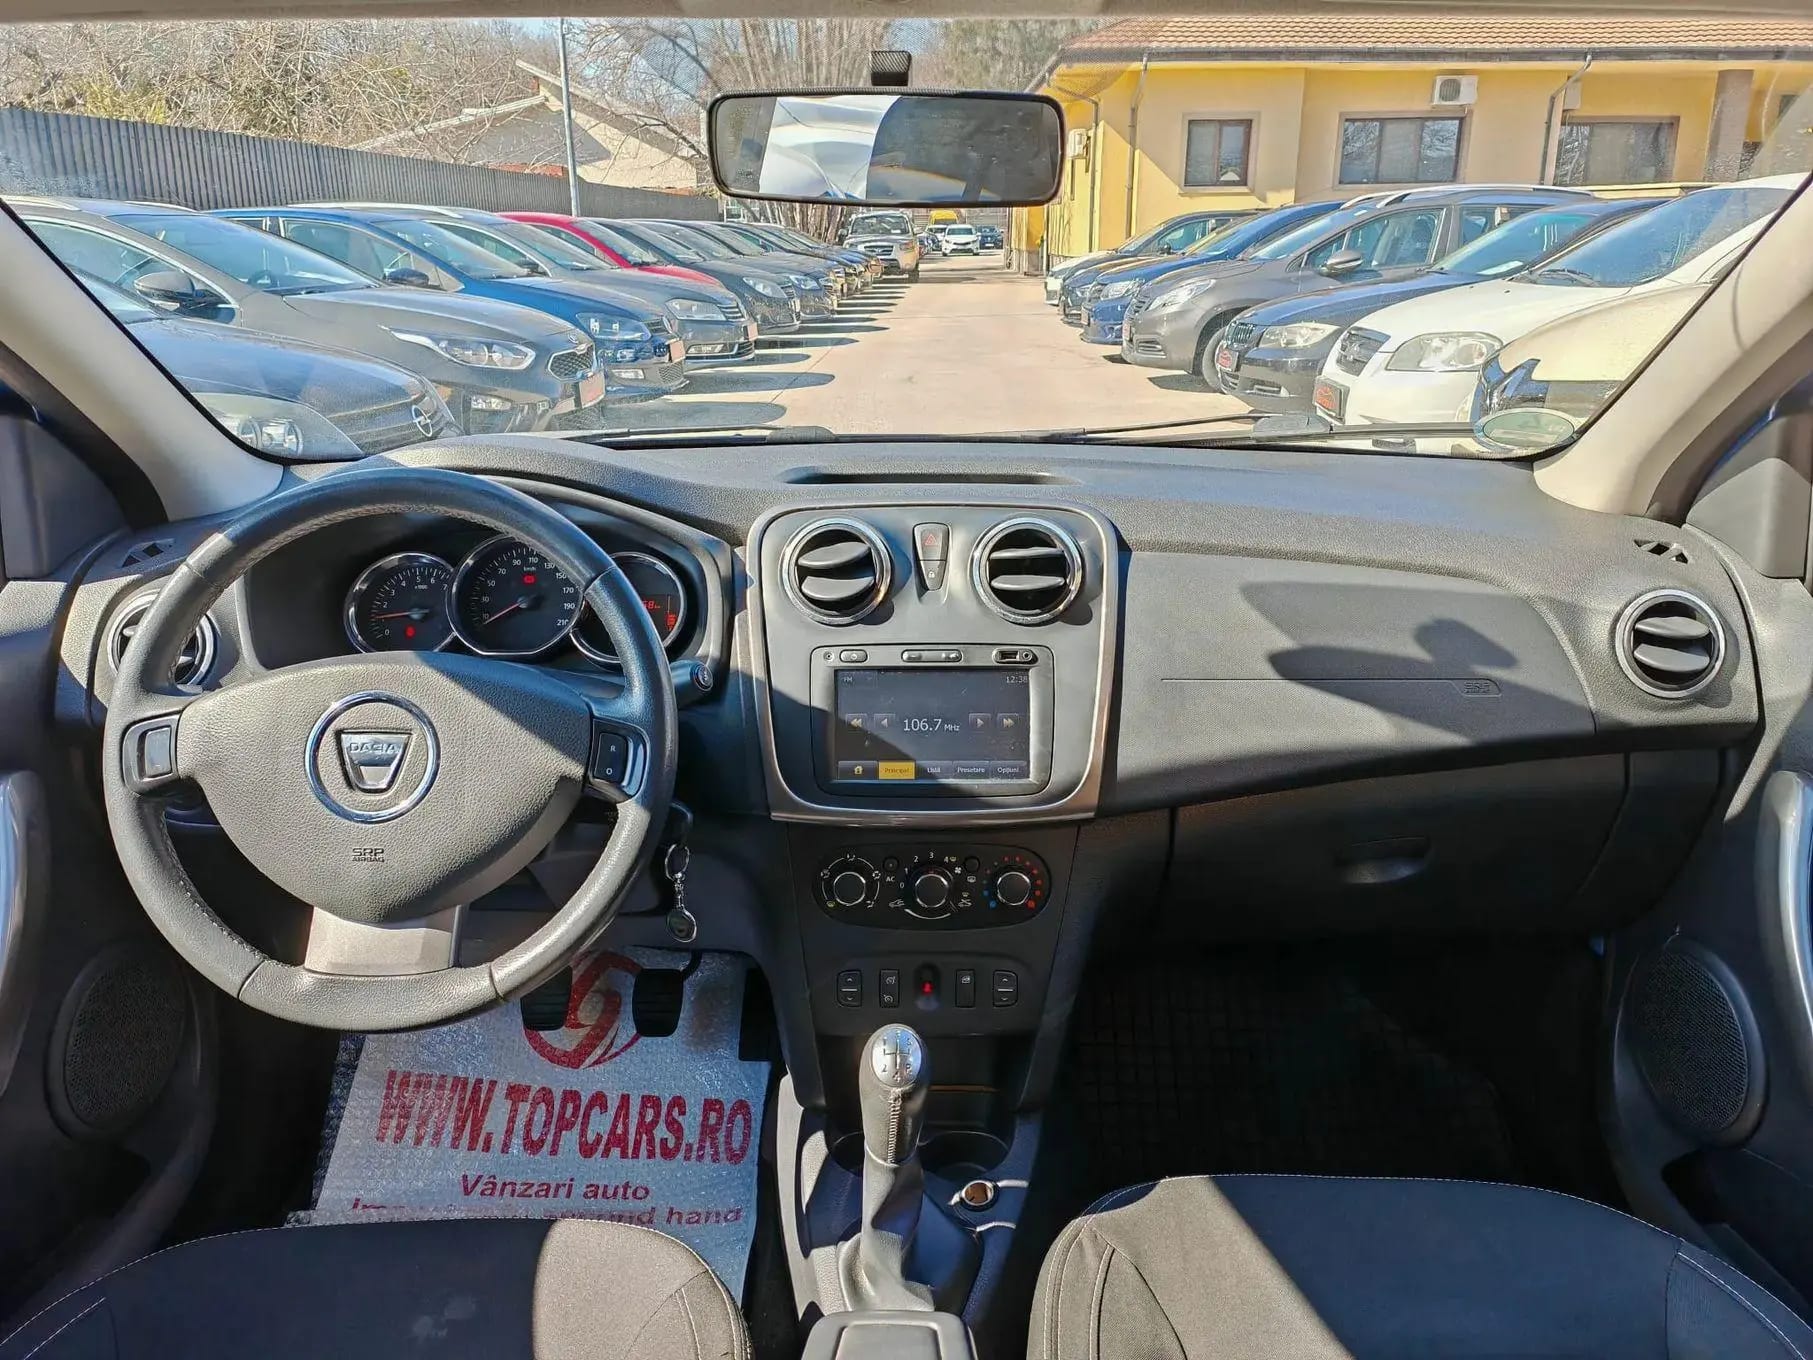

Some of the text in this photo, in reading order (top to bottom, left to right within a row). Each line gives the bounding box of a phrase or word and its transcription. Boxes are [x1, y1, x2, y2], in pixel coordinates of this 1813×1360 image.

[512, 559, 522, 567] 90
[544, 562, 556, 570] 130
[556, 572, 567, 580] 150
[442, 583, 448, 591] 7
[563, 586, 575, 594] 170
[391, 588, 396, 596] 3
[563, 602, 576, 610] 190
[903, 718, 960, 731] 106.7 MHz
[610, 744, 616, 752] R
[914, 855, 919, 863] 2
[929, 851, 934, 859] 3
[375, 1069, 752, 1165] WWW.TOPCARS.RO
[461, 1173, 650, 1201] Vânzari auto
[665, 1205, 743, 1225] hand
